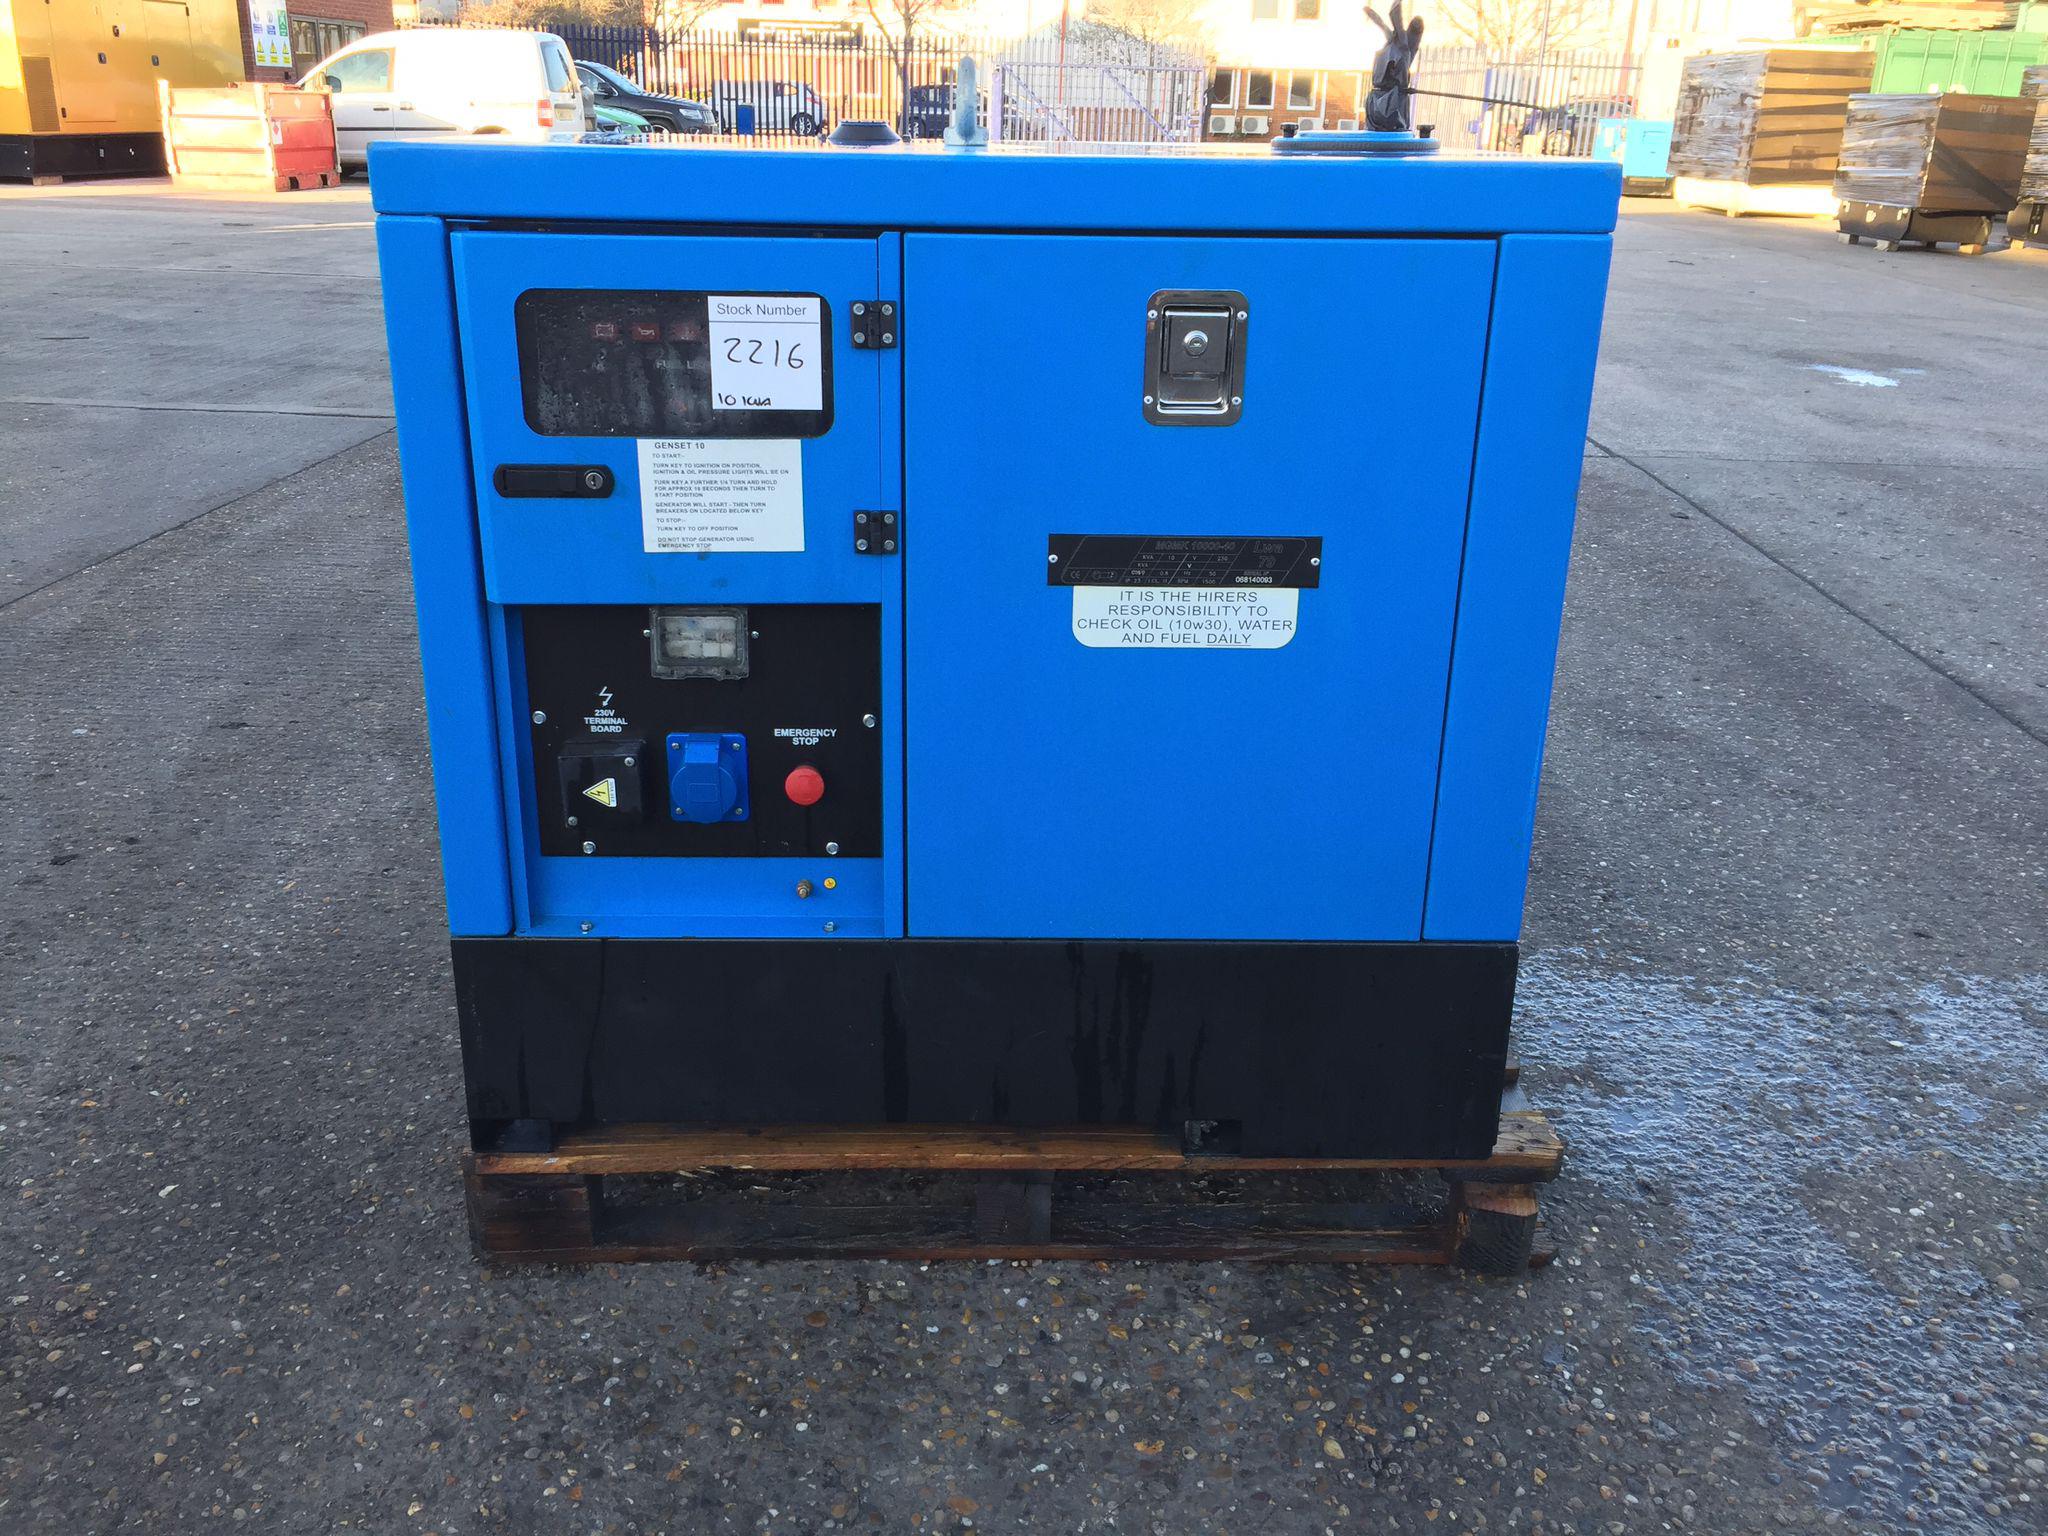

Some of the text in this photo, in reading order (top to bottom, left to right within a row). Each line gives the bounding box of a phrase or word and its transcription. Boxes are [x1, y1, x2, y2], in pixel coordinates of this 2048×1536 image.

[1980, 104, 2000, 114] CAT
[717, 303, 807, 316] Stock Number
[724, 337, 804, 369] 2216
[718, 392, 736, 406] 10
[654, 442, 705, 450] GENSET 10
[1120, 590, 1258, 602] IT IS THE HIRERS
[1108, 604, 1268, 616] RESPONSIBILITY TO
[1077, 618, 1132, 629] CHECK
[1137, 619, 1163, 630] OIL
[1238, 620, 1293, 631] WATER
[1121, 632, 1252, 644] AND FUEL DAILY
[594, 709, 615, 717] 230V
[583, 717, 628, 725] TERMINAL
[590, 725, 622, 733] BOARD
[774, 728, 837, 737] EMERGENCY
[792, 737, 819, 746] STOP
